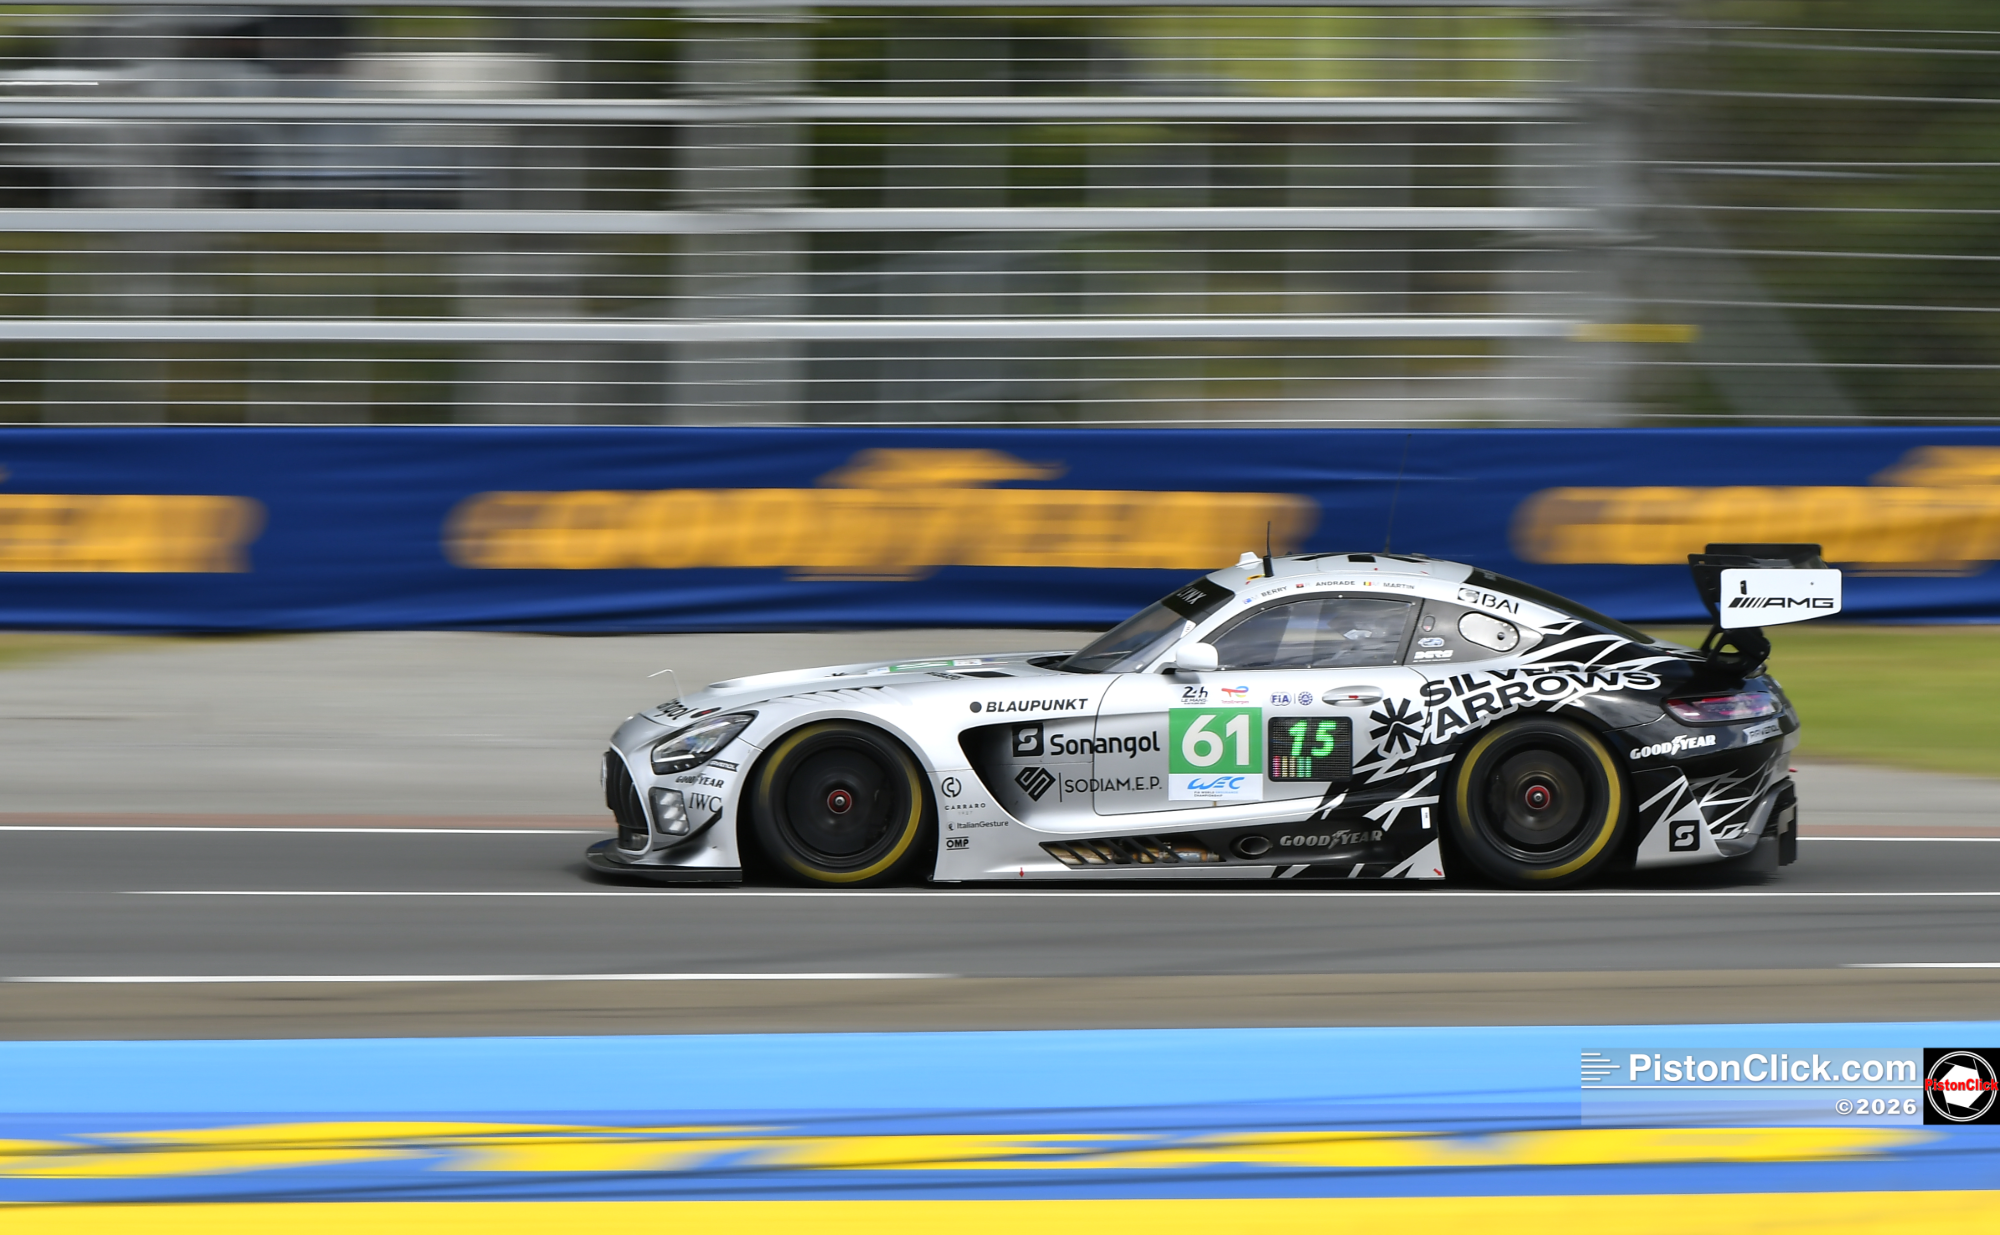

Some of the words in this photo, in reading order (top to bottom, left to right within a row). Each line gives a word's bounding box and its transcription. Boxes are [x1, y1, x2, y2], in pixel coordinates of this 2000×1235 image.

[1260, 585, 1288, 598] BERRY
[1383, 582, 1415, 590] MARTIN
[1481, 593, 1520, 615] BAI
[1760, 597, 1835, 609] AMG
[985, 698, 1089, 713] BLAUPUNKT
[1435, 671, 1663, 739] ARROWS
[1050, 731, 1161, 759] Sonangol
[1182, 714, 1250, 767] 61
[1288, 720, 1337, 757] 15
[1630, 735, 1717, 760] GOODYEAR
[675, 773, 725, 789] GOODYEAR
[1187, 776, 1246, 790] WEC
[688, 792, 723, 813] IWC
[944, 802, 986, 811] CARRARO
[956, 820, 1009, 830] ItalianGesture
[945, 838, 970, 848] OMP
[1280, 829, 1383, 849] GOODYEAR
